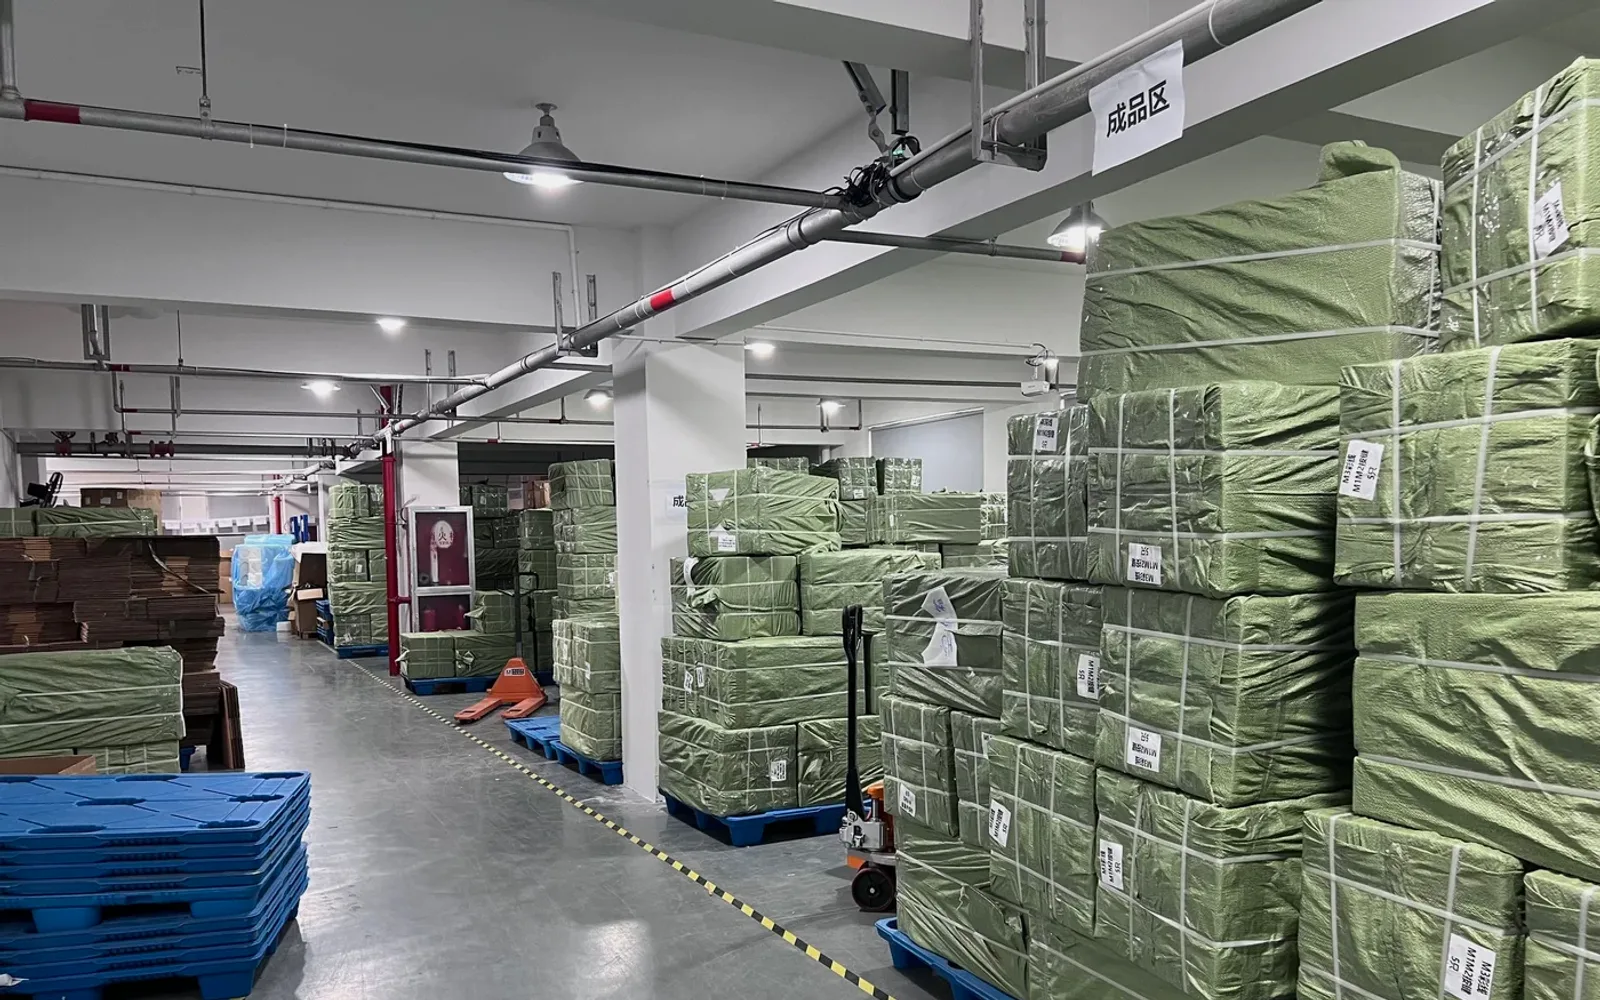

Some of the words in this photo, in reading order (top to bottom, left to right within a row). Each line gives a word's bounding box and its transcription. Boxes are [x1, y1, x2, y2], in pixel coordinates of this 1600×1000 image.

[1106, 79, 1170, 138] 成品区
[1366, 466, 1378, 480] 5只
[672, 495, 688, 508] 成
[1448, 955, 1461, 972] 5只
[1460, 946, 1477, 995] M1M2按键
[1476, 960, 1493, 996] M3彩线
